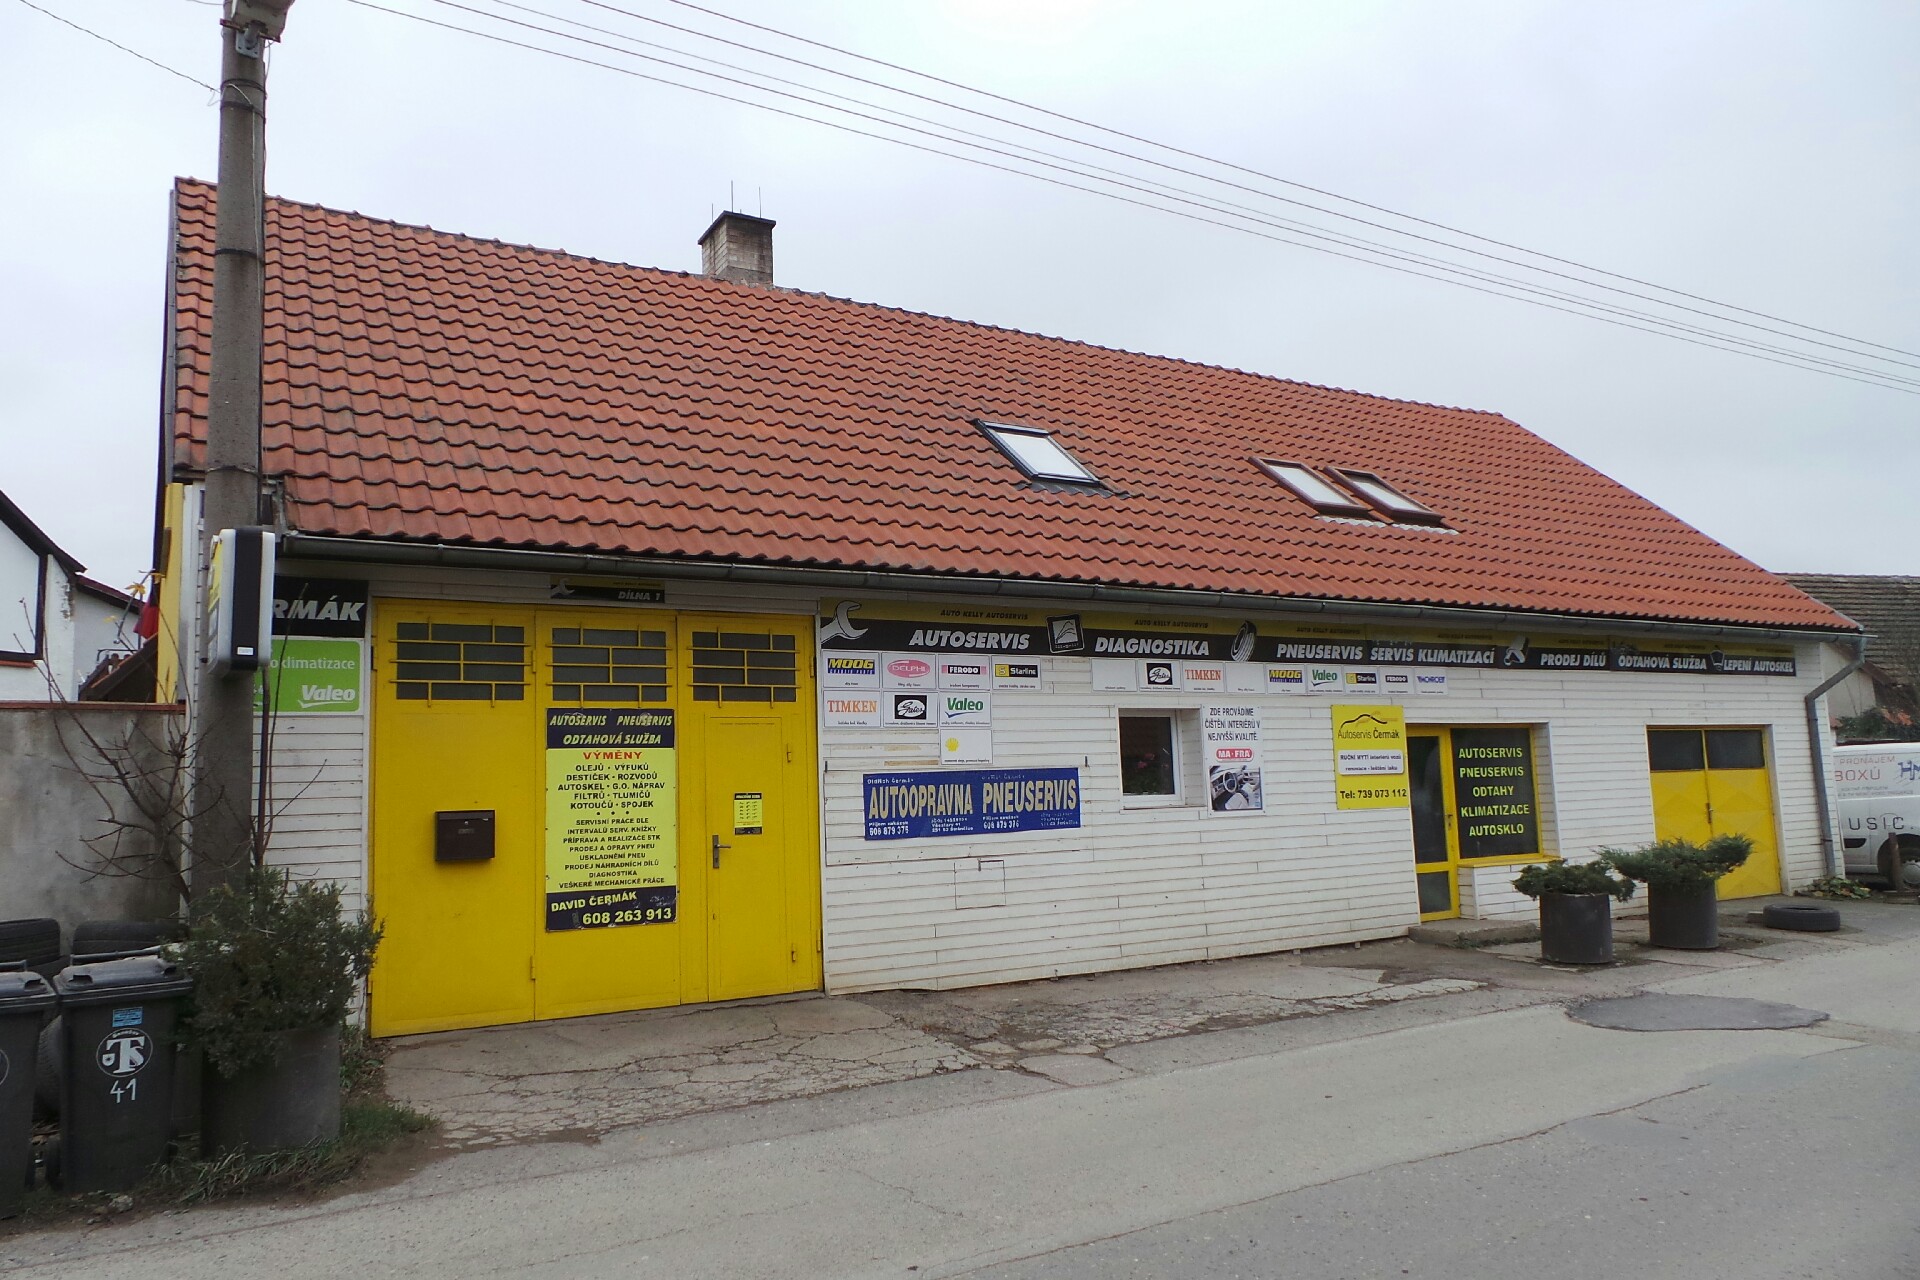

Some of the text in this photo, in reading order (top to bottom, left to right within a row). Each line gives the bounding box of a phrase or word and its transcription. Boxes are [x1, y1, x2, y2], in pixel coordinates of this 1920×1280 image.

[940, 609, 1028, 620] AUTO KELLY AUTOSERVIS
[909, 629, 1030, 650] AUTOSERVIS
[1095, 637, 1209, 656] DIAGNOSTIKA
[1276, 643, 1363, 660] PNEUSERVIS
[1371, 647, 1494, 664] SERVIS KLIMATIZACÍ
[1541, 649, 1605, 667] PRODEJ DÍLŮ
[829, 658, 874, 669] MOOG
[1618, 653, 1706, 670] ODTAHOVÁ SLUŽBA
[1754, 660, 1793, 672] AUTOSKEL
[949, 666, 979, 674] FERODO
[1185, 669, 1221, 680] TIMKEN
[1269, 670, 1302, 678] MOOG
[1312, 669, 1338, 680] Valeo
[302, 685, 355, 701] Valeo
[828, 700, 877, 713] TIMKEN
[947, 697, 984, 711] Valeo
[1210, 708, 1221, 716] ZDE
[550, 715, 672, 726] AUTOSERVIS PNEUSERVIS
[563, 732, 661, 745] ODTAHOVÁ SLUŽBA
[1338, 727, 1399, 739] Autoservis Čermák
[583, 750, 642, 760] VÝMĚNY
[1459, 748, 1522, 758] AUTOSERVIS
[576, 762, 649, 771] OLEJŮ VÝFUKŮ
[1460, 767, 1524, 777] PNEUSERVIS
[566, 771, 657, 781] DESTIČEK ROZVODŮ
[558, 782, 604, 790] AUTOSKEL
[632, 781, 665, 789] NÁPRAV
[1473, 786, 1514, 796] ODTAHY
[574, 791, 604, 800] FILTRŮ
[982, 779, 1077, 813] PNEUSERVIS
[1340, 788, 1407, 799] Tel: 739 073 112
[869, 784, 973, 819] AUTOOPRAVNA
[1461, 804, 1530, 817] KLIMATIZACE
[1469, 824, 1524, 836] AUTOSKLO
[589, 870, 637, 878] DIAGNOSTIKA
[559, 879, 592, 889] VEŠKERÉ
[552, 892, 637, 912] DAVID ČERMÁK
[583, 908, 672, 924] 608 263 913
[110, 1078, 136, 1103] 41
